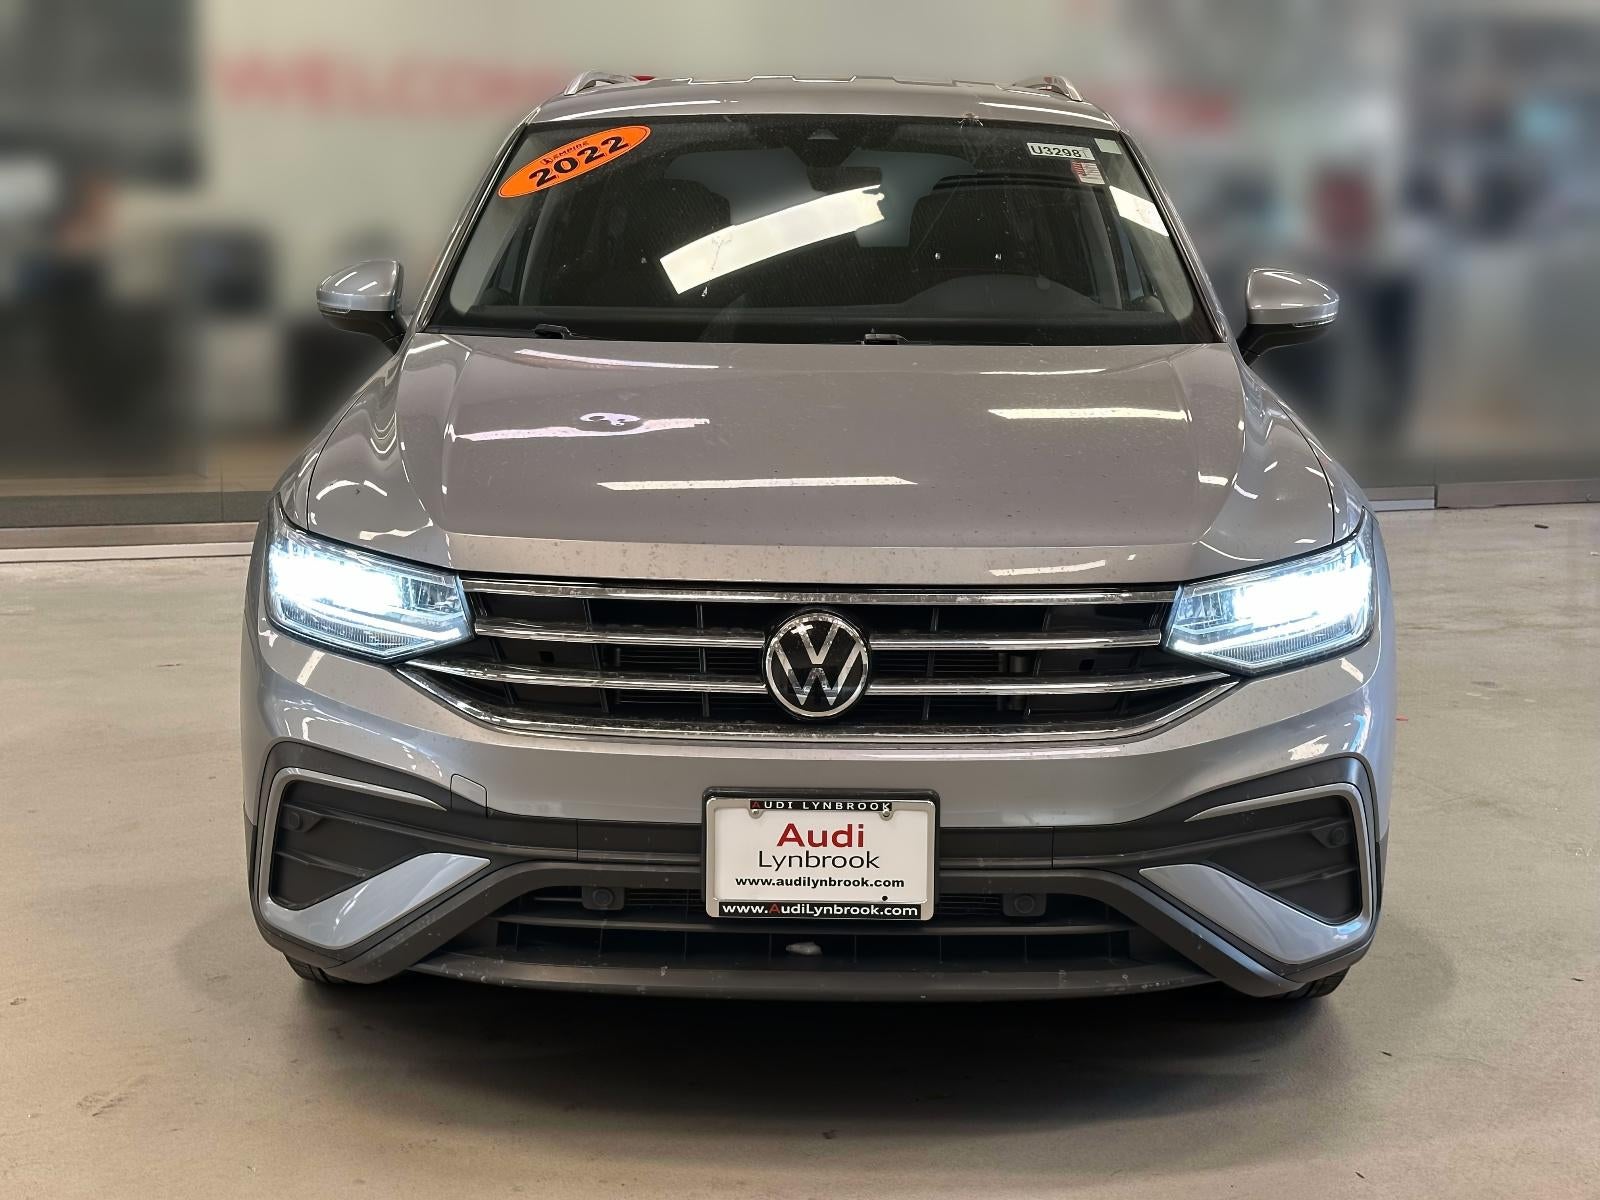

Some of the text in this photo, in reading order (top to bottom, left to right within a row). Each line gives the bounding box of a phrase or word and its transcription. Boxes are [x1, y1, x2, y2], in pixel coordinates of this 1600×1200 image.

[528, 136, 629, 187] 2022
[751, 801, 890, 811] AUDI LYNBROOK
[776, 823, 865, 848] Audi
[758, 850, 880, 871] Lynbrook
[735, 877, 905, 889] www.audilynbrook.com
[722, 903, 918, 917] www.AudiLynbrook.com
